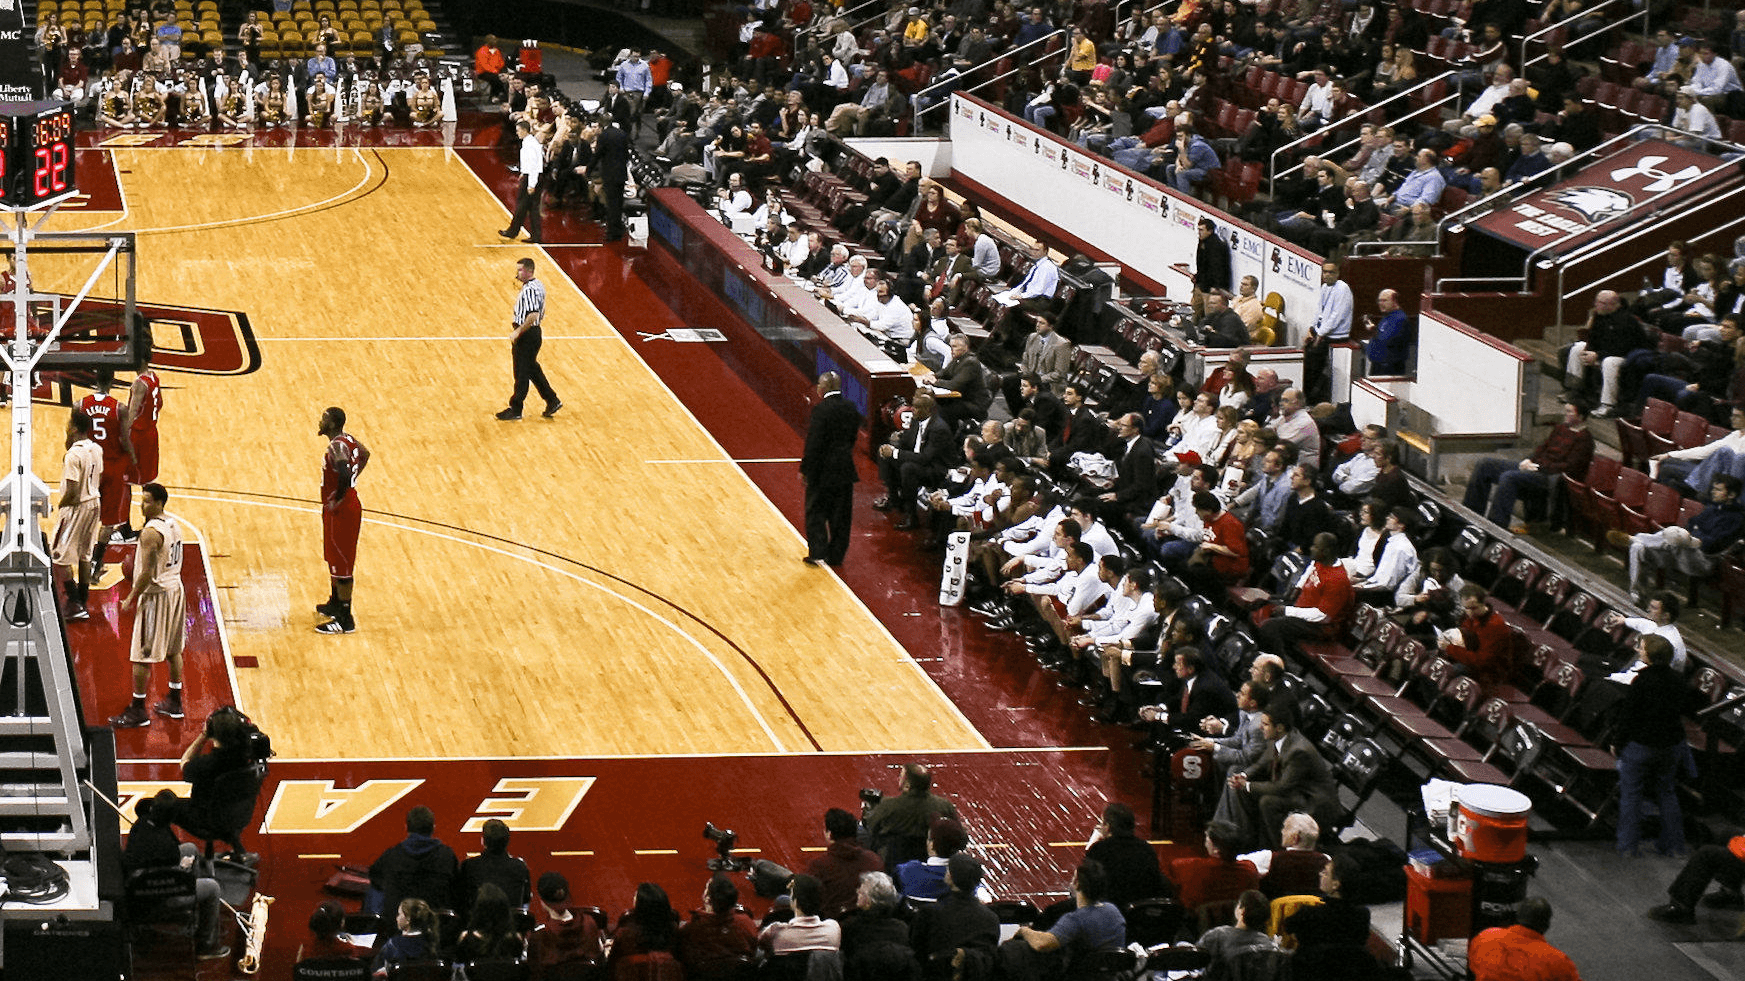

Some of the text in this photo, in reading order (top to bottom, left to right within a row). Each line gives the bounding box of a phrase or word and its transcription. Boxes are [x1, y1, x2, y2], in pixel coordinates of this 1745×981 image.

[34, 142, 68, 197] 22
[1512, 203, 1546, 217] THE
[86, 405, 111, 417] LESLIE
[92, 418, 107, 440] 5
